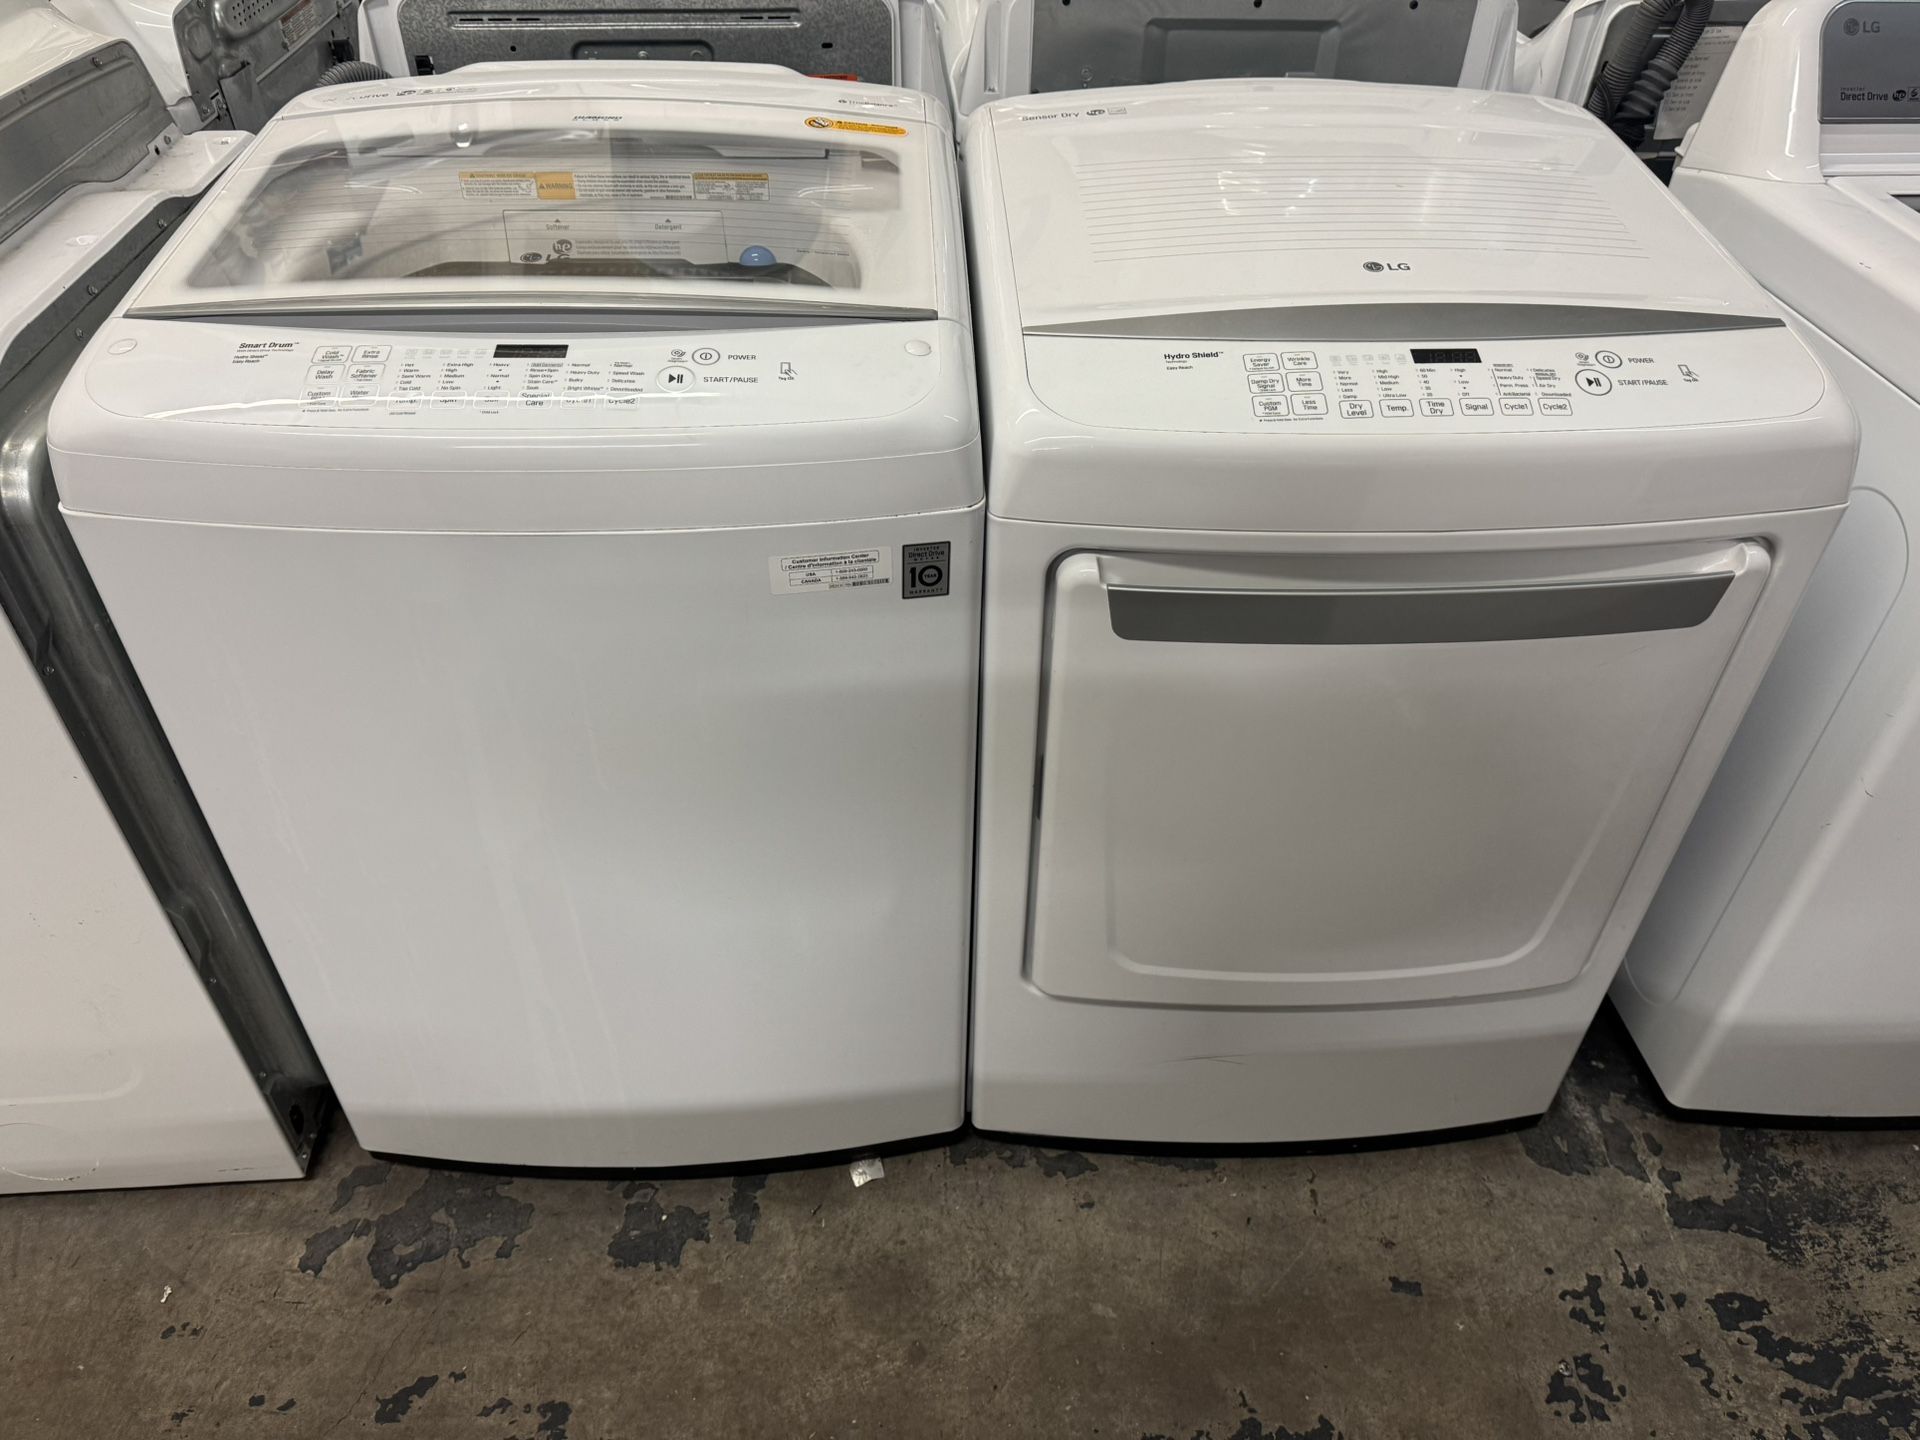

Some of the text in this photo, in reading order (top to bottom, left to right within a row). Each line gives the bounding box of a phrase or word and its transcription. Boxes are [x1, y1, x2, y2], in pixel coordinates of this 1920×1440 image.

[1863, 21, 1881, 33] LG
[1840, 92, 1889, 100] Direct Drive
[546, 182, 574, 191] WARNING
[1386, 262, 1411, 271] LG
[1464, 404, 1488, 412] Signal
[819, 554, 850, 562] Information
[910, 565, 944, 588] 10
